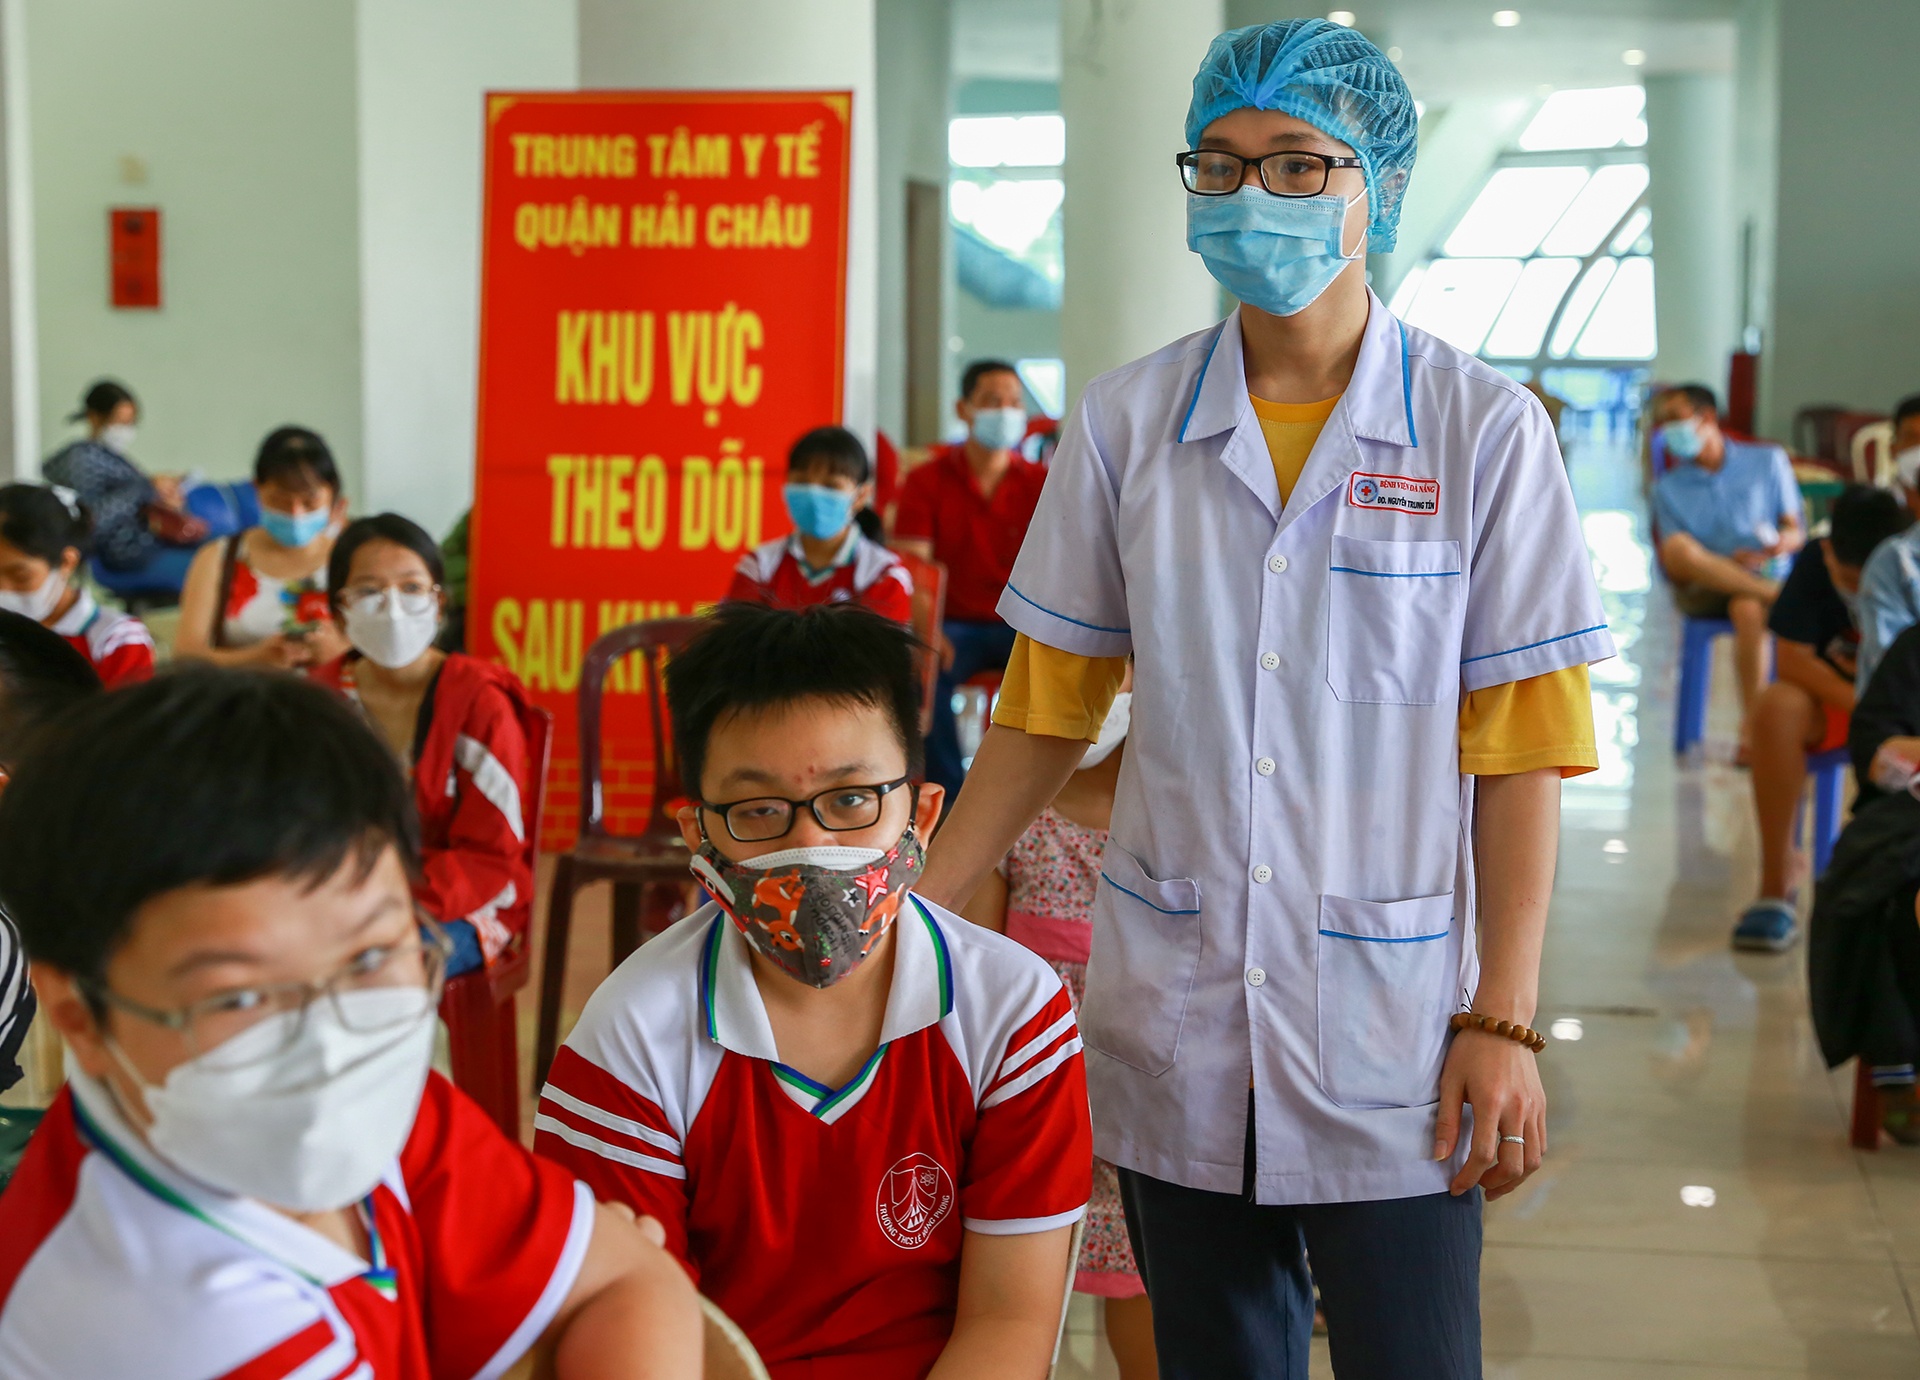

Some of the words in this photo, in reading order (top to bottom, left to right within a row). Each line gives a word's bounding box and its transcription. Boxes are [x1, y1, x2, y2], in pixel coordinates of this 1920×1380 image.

[511, 133, 637, 178] TRUNG
[646, 125, 731, 178] TÂM
[740, 134, 766, 178] Y
[774, 118, 825, 178] TẾ
[514, 195, 621, 257] QUẬN
[630, 190, 697, 249] HẢI
[706, 195, 812, 248] CHÂU
[555, 310, 655, 406] KHU
[667, 301, 764, 428] VỰC
[546, 454, 668, 551] THEO
[679, 438, 764, 552] DÕI
[492, 598, 584, 693] SAU
